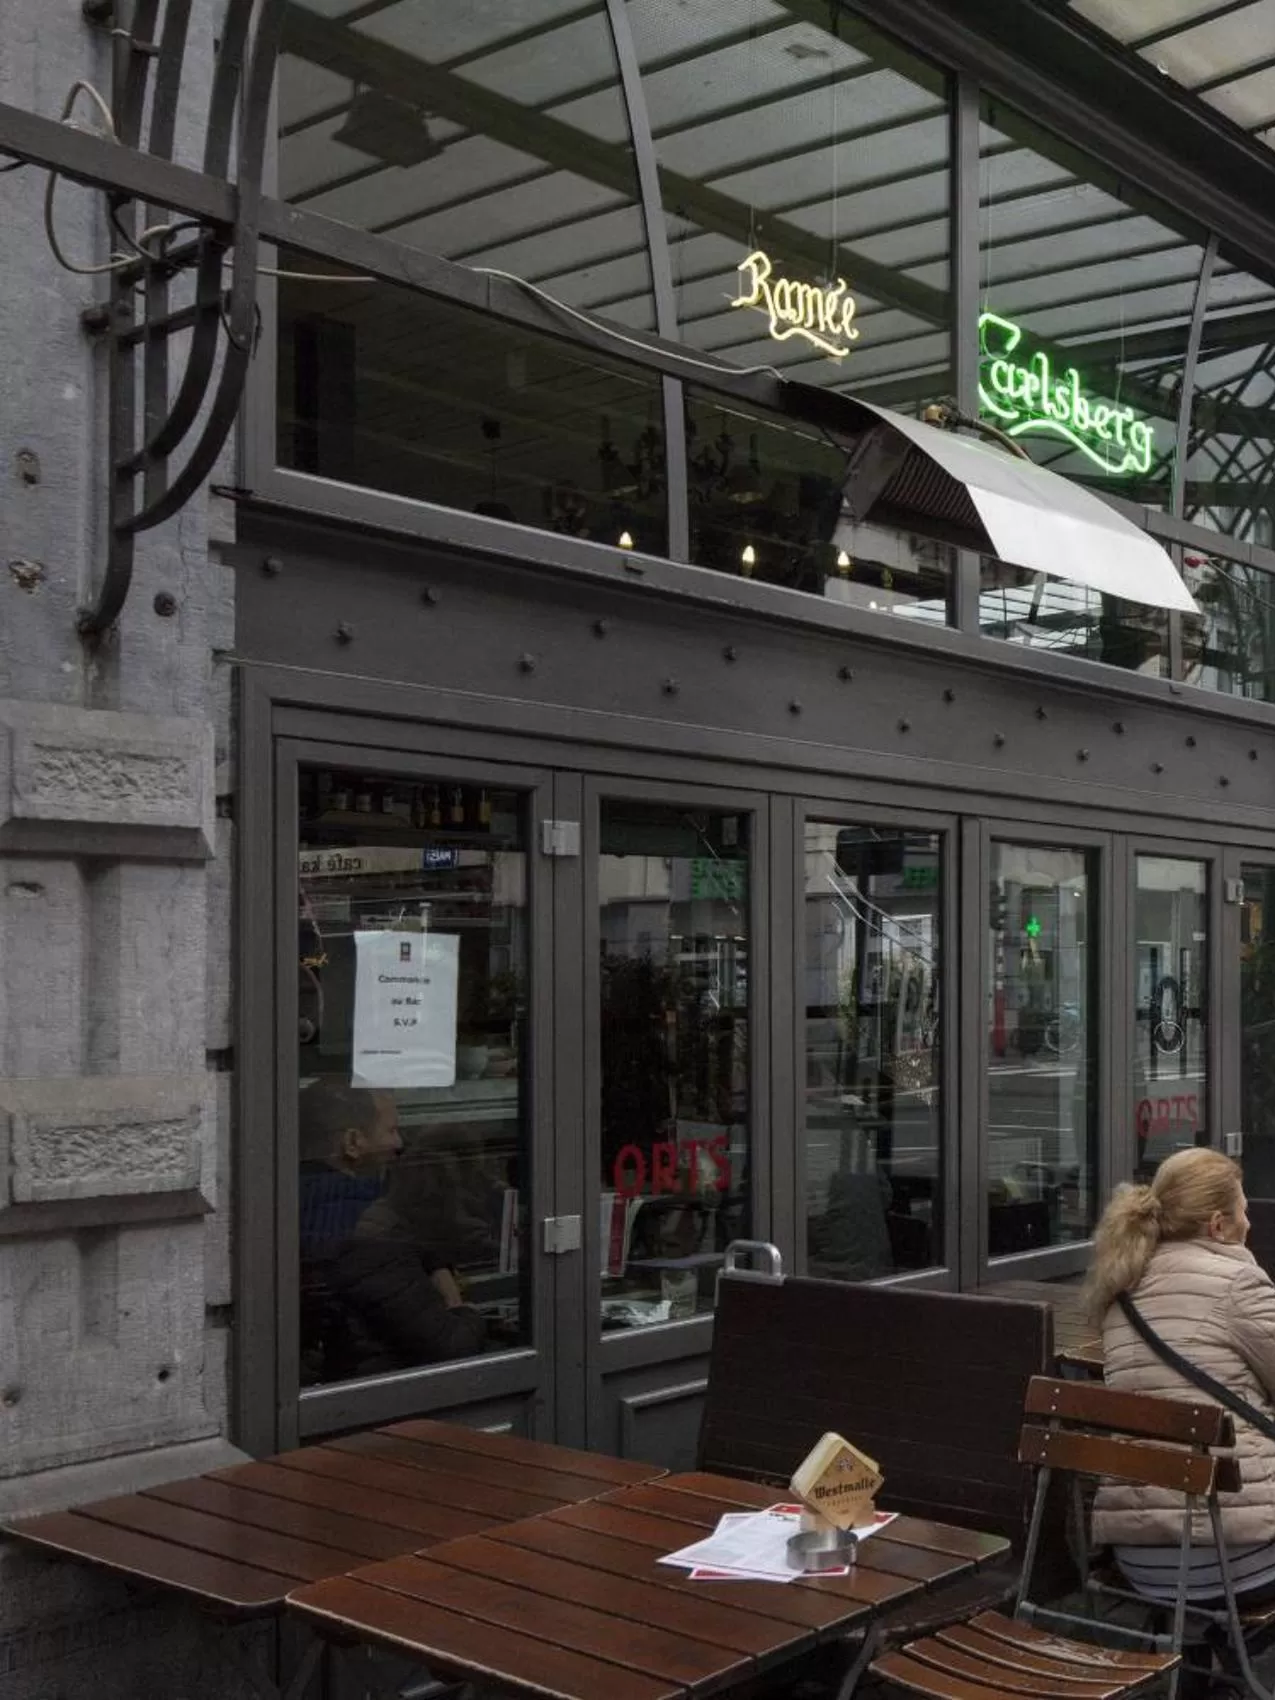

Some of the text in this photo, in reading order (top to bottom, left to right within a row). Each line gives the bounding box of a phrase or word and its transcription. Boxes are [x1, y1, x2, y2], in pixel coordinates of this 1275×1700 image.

[978, 313, 1155, 473] Carlsberg
[613, 1135, 731, 1198] ORTS
[814, 1477, 877, 1499] Westmalle
